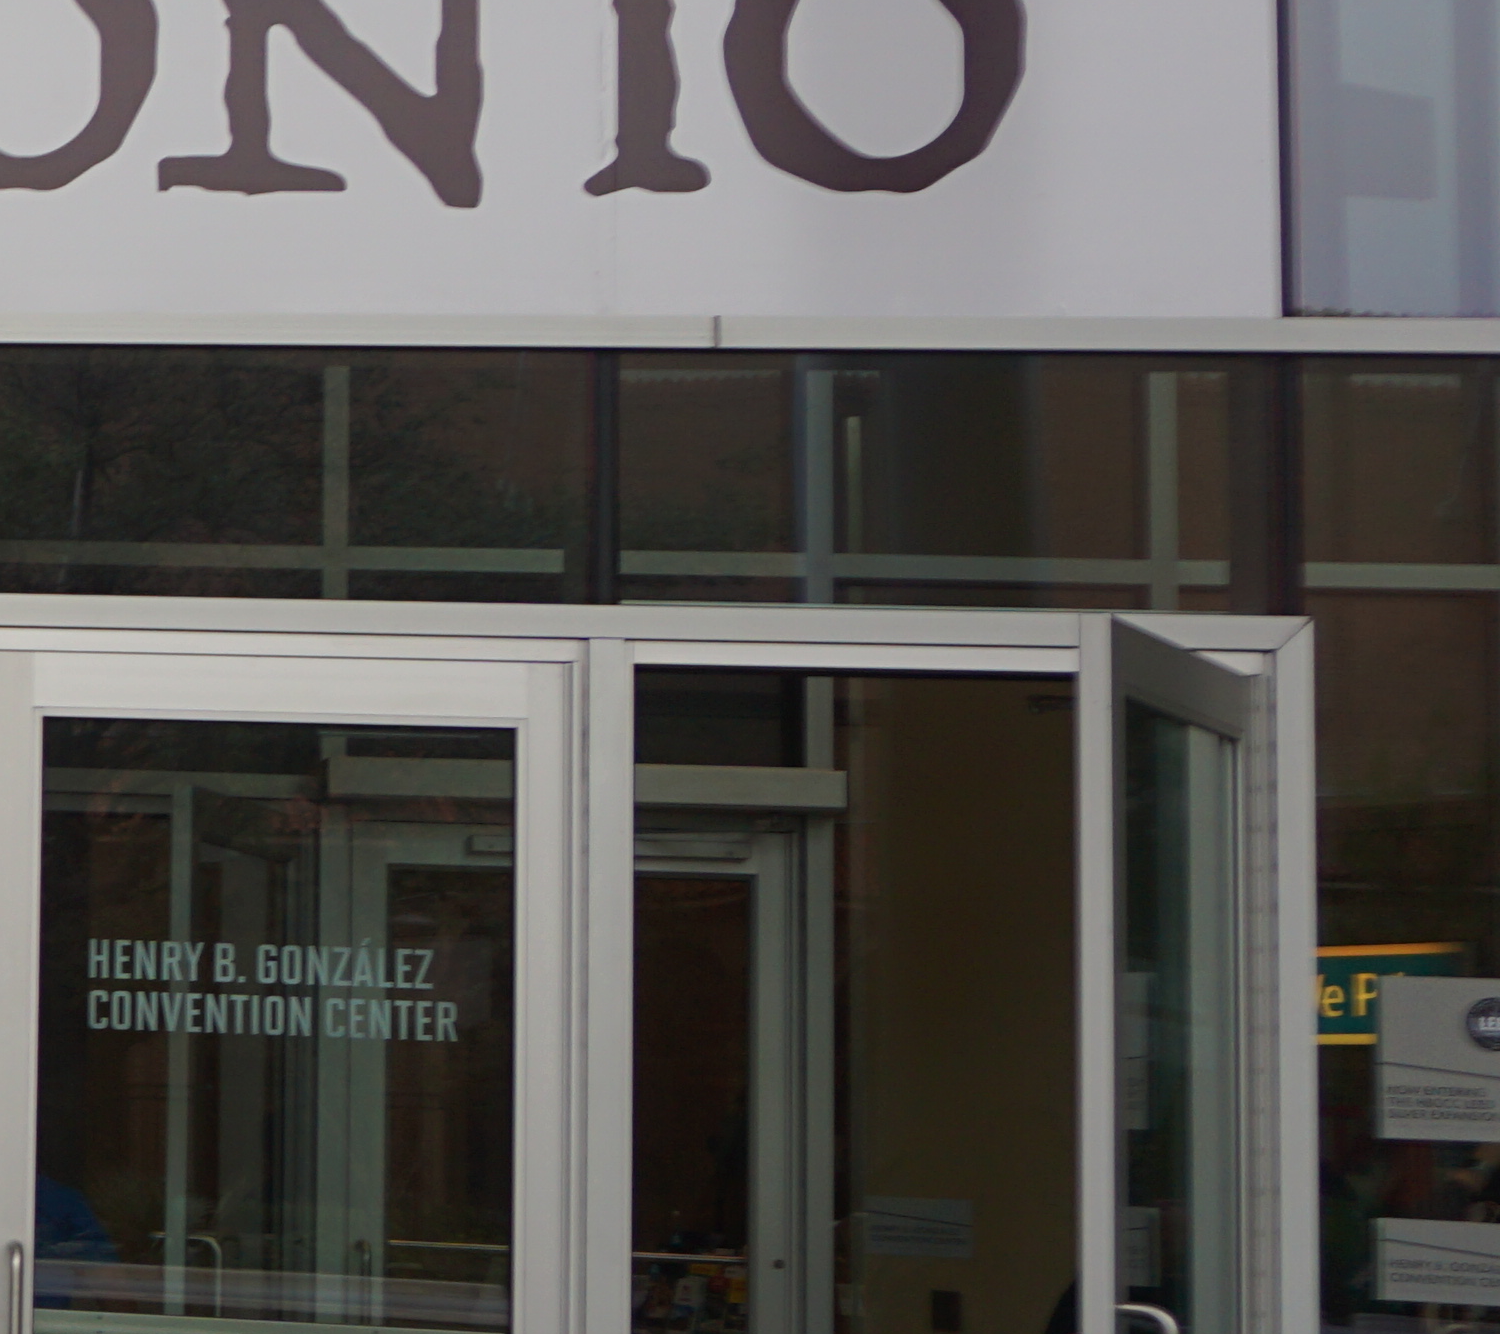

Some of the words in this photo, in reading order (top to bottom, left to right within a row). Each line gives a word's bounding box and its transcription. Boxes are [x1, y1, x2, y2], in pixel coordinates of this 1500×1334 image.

[87, 938, 205, 982] HENRY
[213, 942, 246, 983] B.
[256, 937, 433, 990] GONZÁLEZ
[87, 990, 313, 1037] CONVENTION
[325, 997, 458, 1042] CENTER
